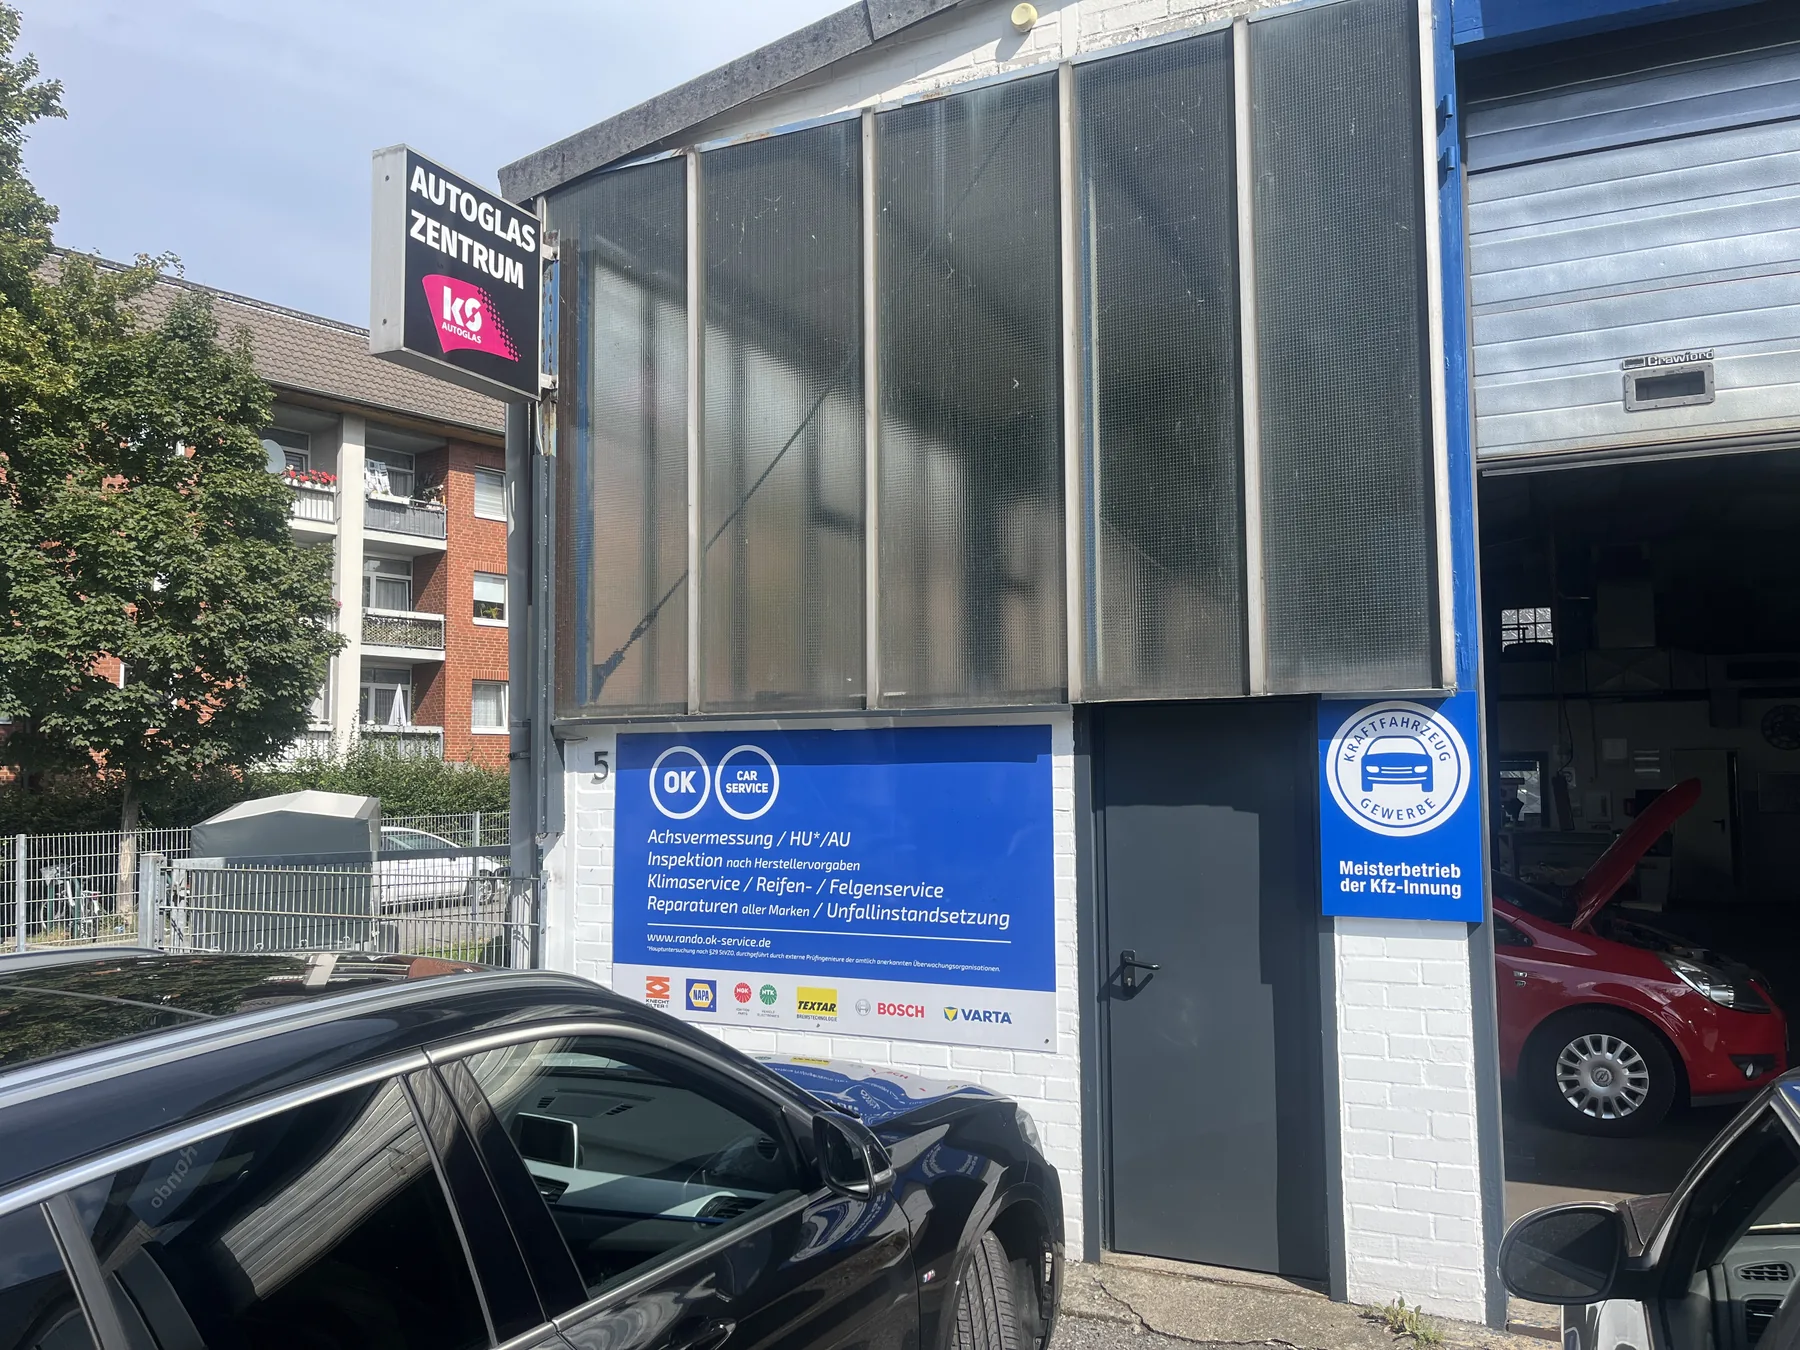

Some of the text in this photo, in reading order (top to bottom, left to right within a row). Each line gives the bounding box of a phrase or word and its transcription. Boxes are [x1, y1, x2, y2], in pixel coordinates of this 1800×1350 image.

[410, 165, 536, 252] AUTOGLAS
[410, 210, 524, 290] ZENTRUM
[442, 322, 482, 344] AUTOGLAS
[1648, 348, 1714, 366] Crawford
[1343, 716, 1450, 762] KRAFTFAHRZEUG
[593, 751, 608, 781] 5
[736, 770, 758, 781] CAR
[664, 770, 696, 794] OK
[726, 782, 768, 794] SERVICE
[1360, 798, 1436, 820] GEWERBE
[648, 829, 773, 850] Achsvermessung
[648, 852, 860, 873] Inspektion nach Herstellervorgaben
[1339, 860, 1461, 879] Meisterbetrieb
[648, 874, 740, 891] Klimaservice
[756, 877, 812, 896] Reifen-
[830, 878, 944, 898] Felgenservice
[1340, 878, 1462, 899] der Kfz-Innung
[648, 896, 738, 914] Reparaturen
[742, 904, 767, 914] aller
[768, 904, 810, 916] Marken
[826, 902, 1010, 930] Unfallinstandsetzung
[647, 934, 771, 948] www.rando.ok-service.de
[693, 990, 710, 1002] NAPA
[798, 1000, 836, 1012] TEXTAR
[878, 1002, 924, 1018] BOSCH
[961, 1008, 1012, 1024] VARTA
